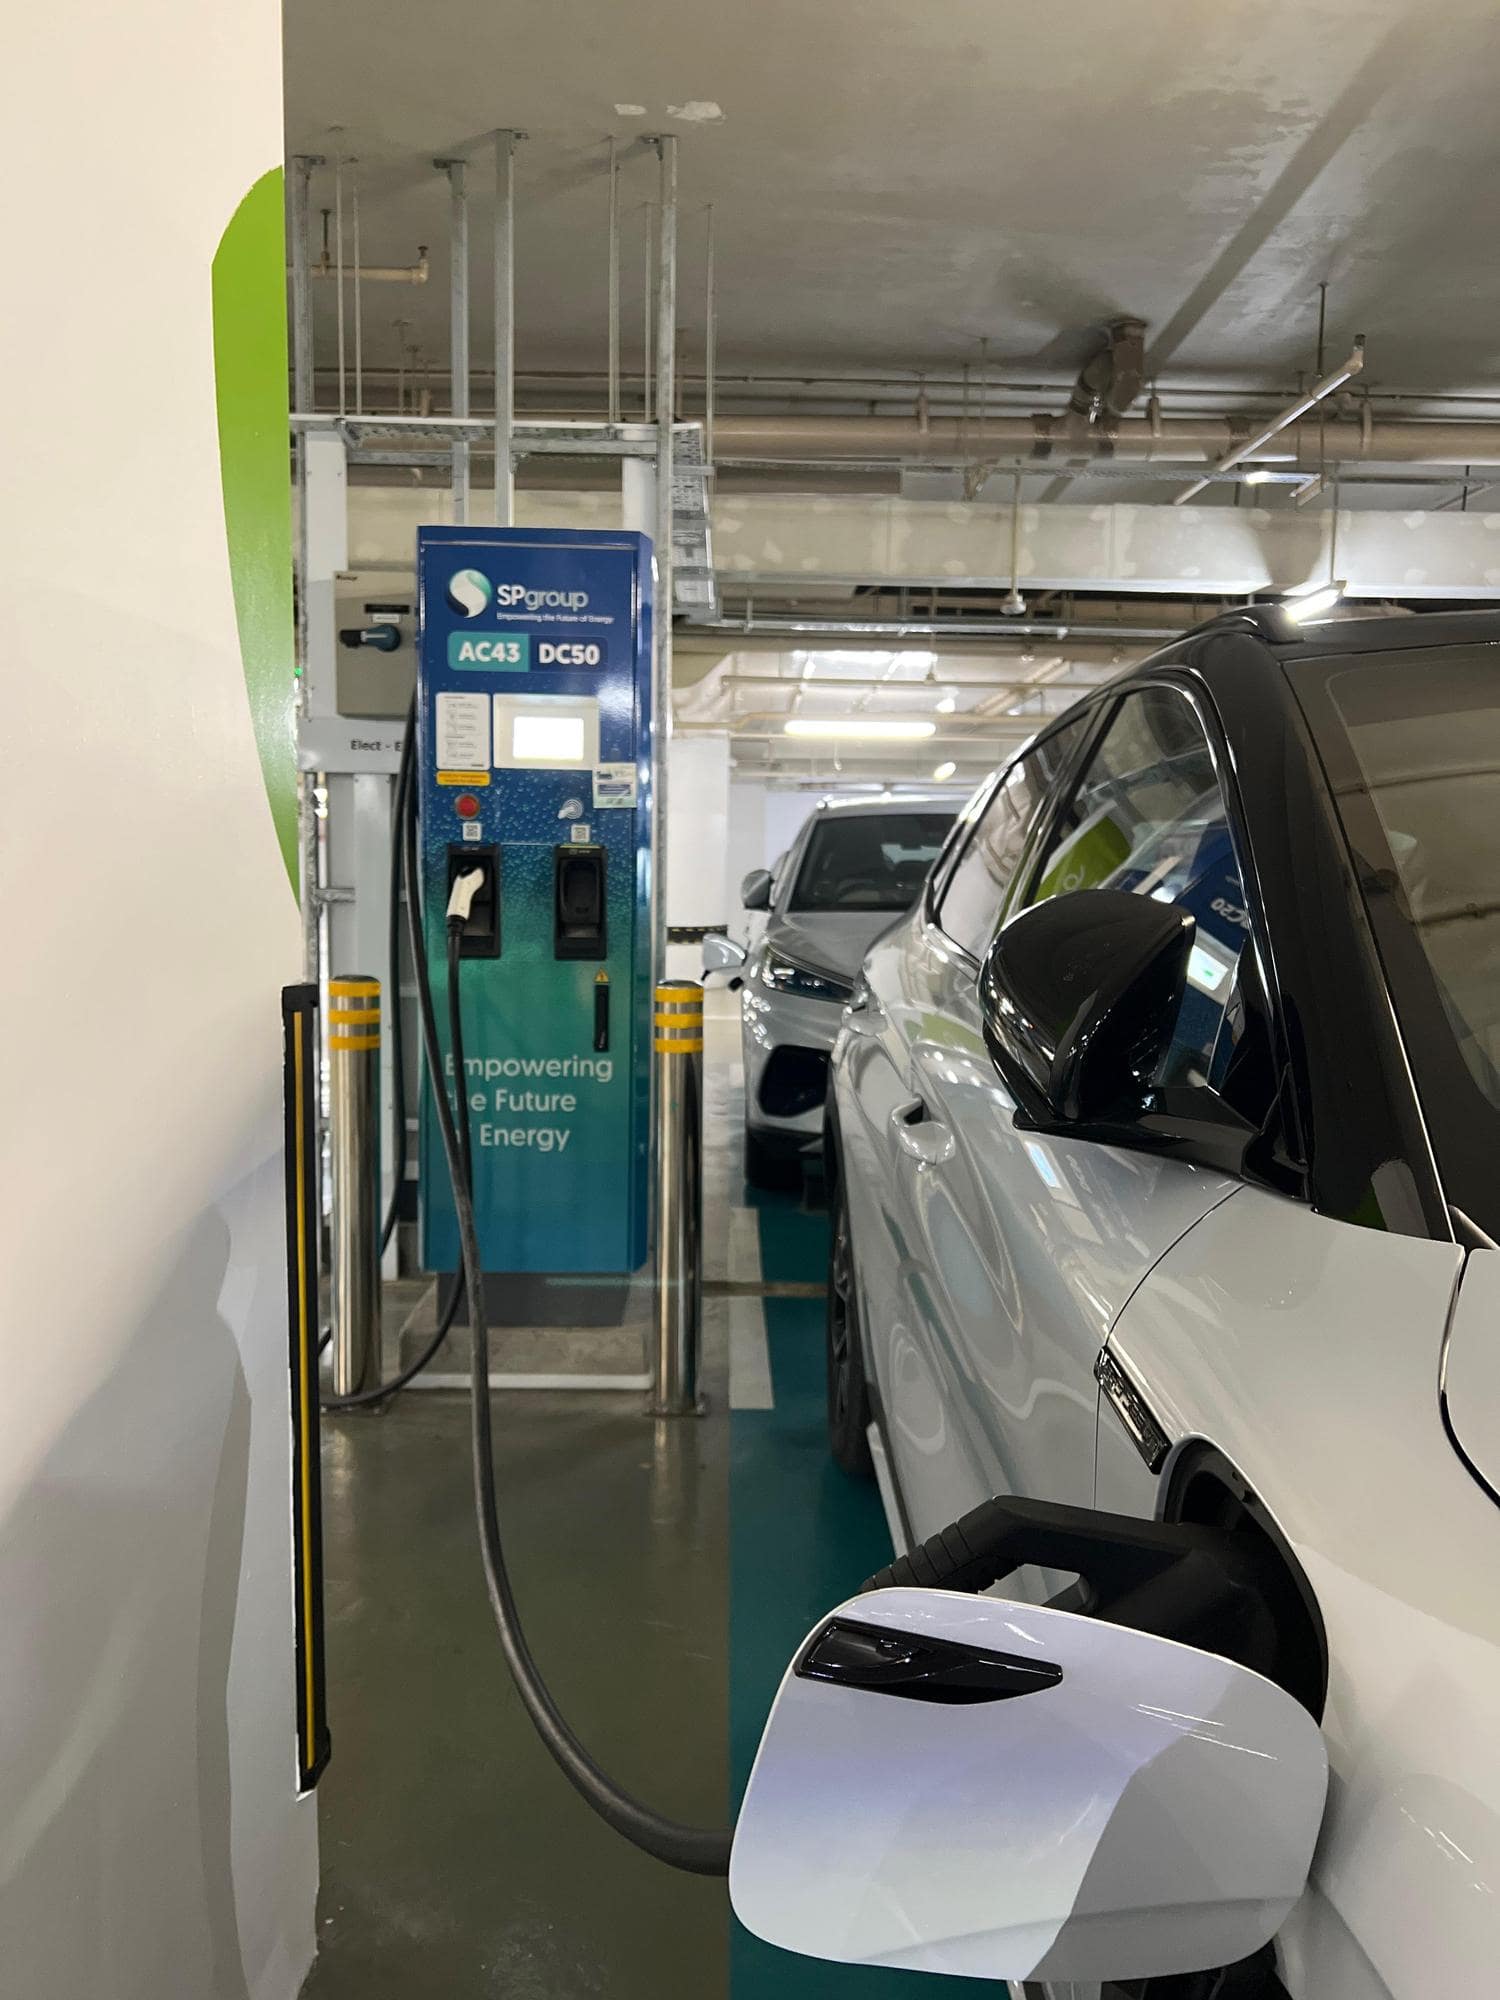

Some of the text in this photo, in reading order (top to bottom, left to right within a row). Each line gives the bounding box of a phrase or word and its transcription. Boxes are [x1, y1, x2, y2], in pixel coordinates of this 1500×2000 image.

[458, 641, 601, 665] AC43 DC50
[350, 739, 382, 752] Elect
[445, 1053, 613, 1083] Empowering
[495, 1088, 577, 1112] Future
[479, 1123, 570, 1152] Energy
